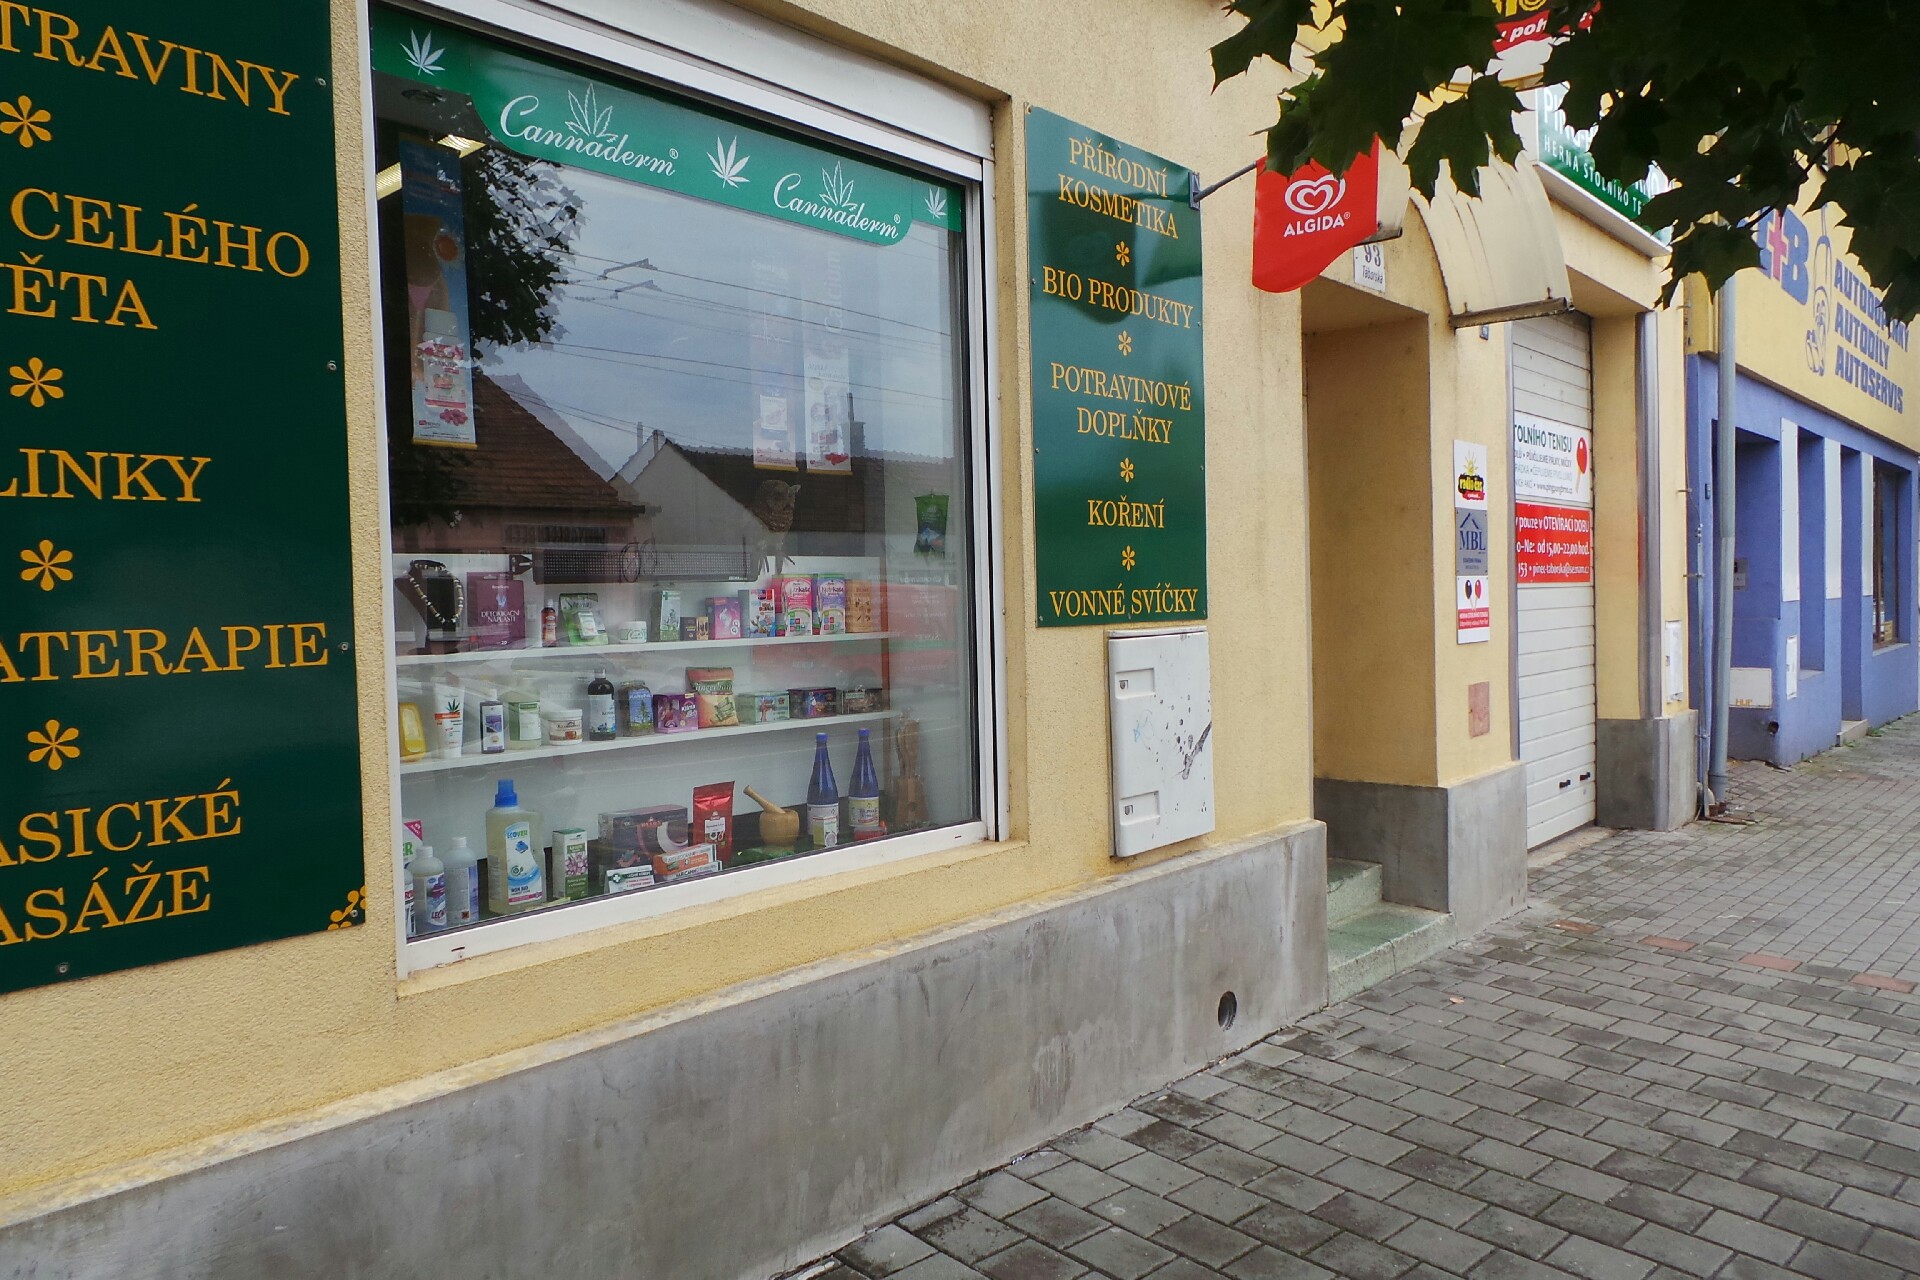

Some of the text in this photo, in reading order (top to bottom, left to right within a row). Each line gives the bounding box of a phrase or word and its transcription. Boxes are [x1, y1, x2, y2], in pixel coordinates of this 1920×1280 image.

[1069, 137, 1168, 198] PŘÍRODNÍ
[1544, 135, 1579, 172] HERNA
[1058, 173, 1179, 240] KOSMETIKA
[10, 187, 310, 278] CELÉHO
[1283, 213, 1345, 238] ALGIDA
[0, 252, 158, 330] ĚTA
[1043, 265, 1194, 330] BIO PRODUKTY
[1834, 302, 1890, 371] AUTODÍLY
[1051, 362, 1192, 411] POTRAVINOVÉ
[1834, 345, 1905, 414] AUTOSERVIS
[1077, 408, 1173, 444] DOPLŇKY
[1547, 431, 1572, 453] TENISU
[1087, 495, 1165, 528] KOŘENÍ
[1519, 516, 1538, 532] pouze
[1543, 514, 1573, 531] OTEVÍRACÍ
[1574, 518, 1589, 532] DOBU
[1459, 530, 1486, 551] MBL
[1537, 539, 1546, 553] od
[1050, 583, 1198, 617] VONNÉ SVÍČKY
[507, 830, 528, 839] ECOVER
